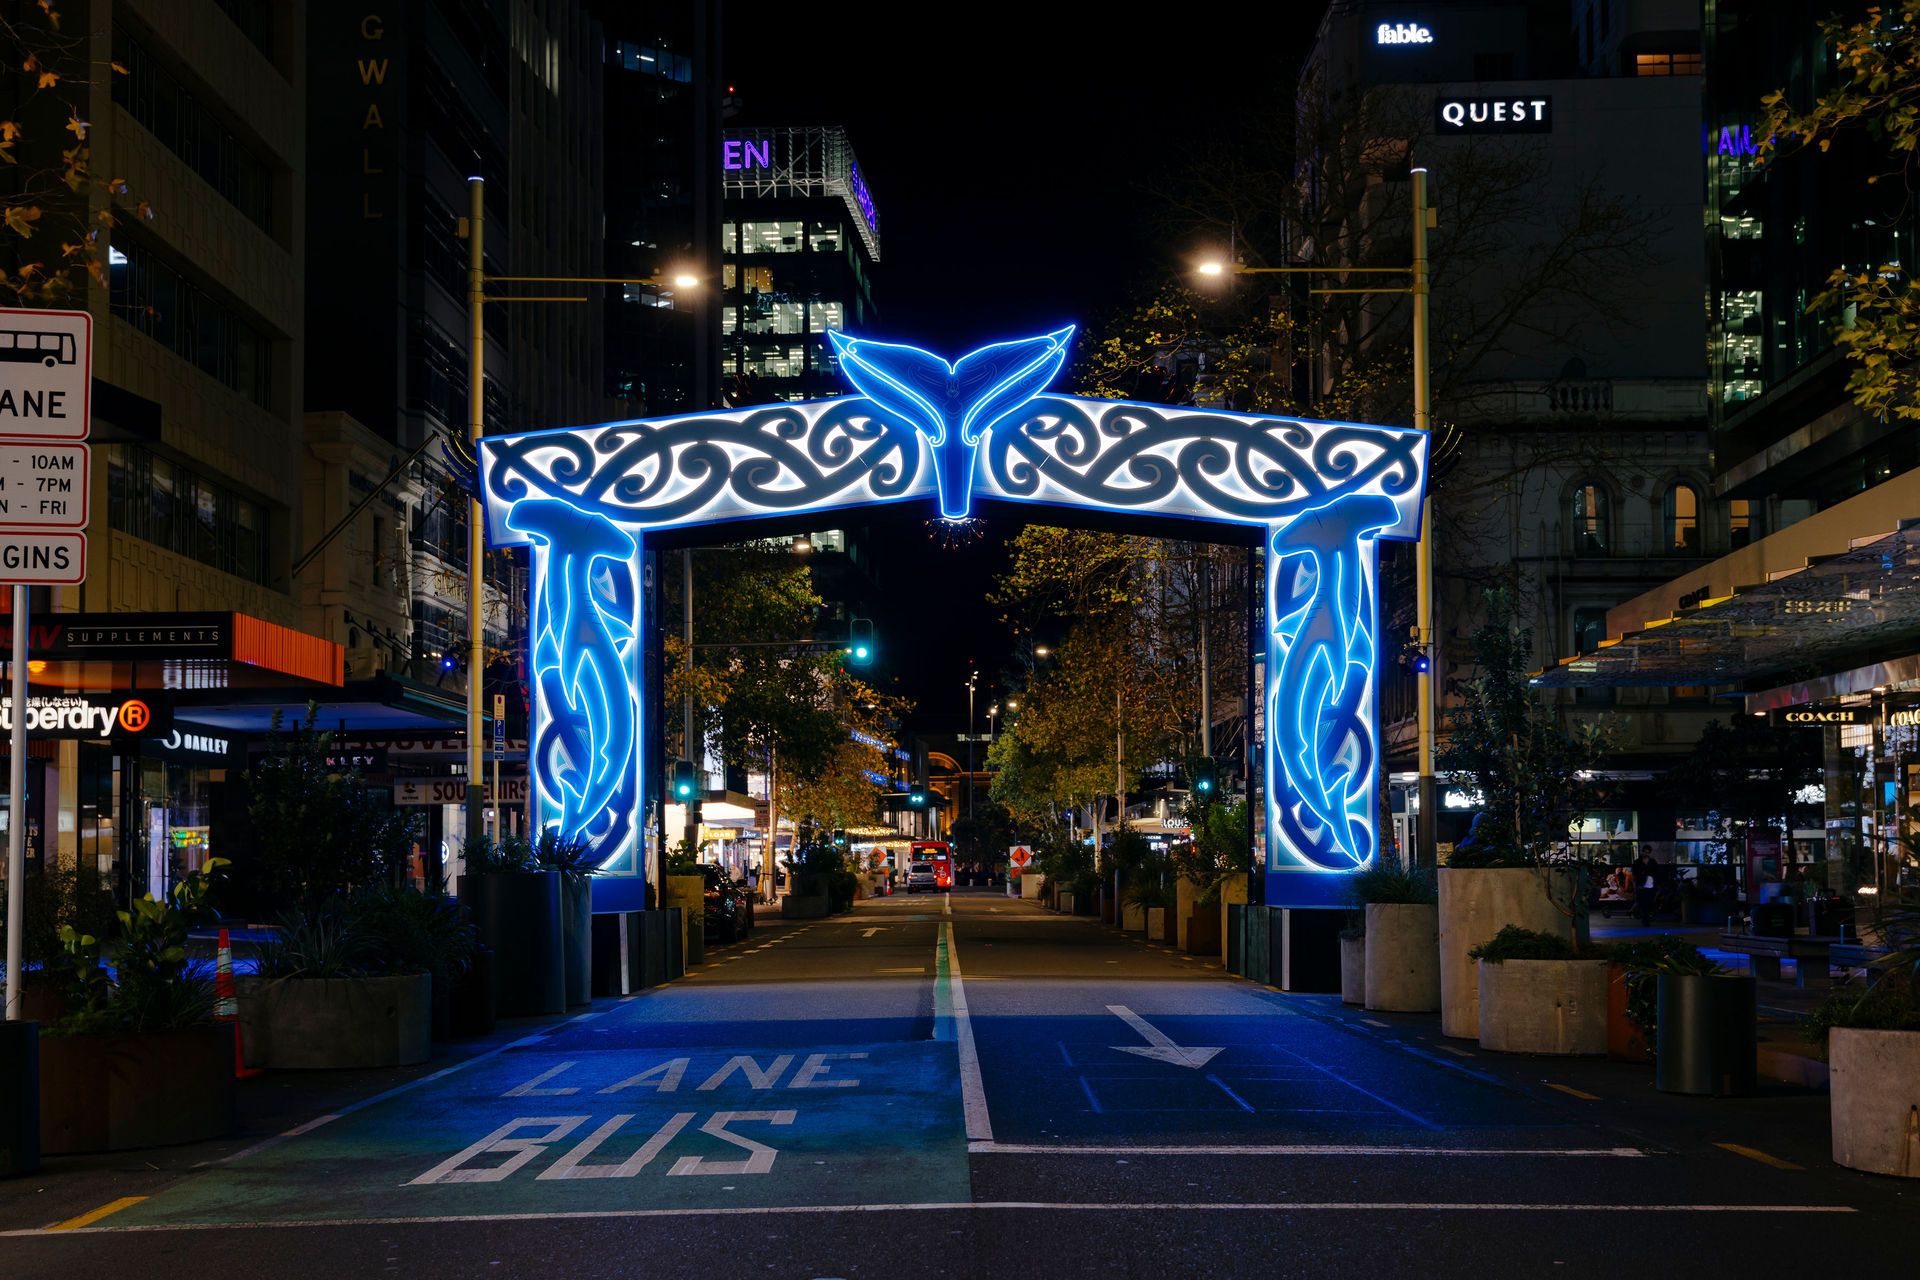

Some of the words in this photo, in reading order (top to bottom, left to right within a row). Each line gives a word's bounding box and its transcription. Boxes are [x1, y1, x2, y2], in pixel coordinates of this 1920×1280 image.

[1377, 23, 1434, 44] fable.
[1442, 100, 1546, 127] QUEST
[723, 140, 769, 170] EN
[31, 455, 74, 470] 10AM
[36, 477, 71, 492] 7PM
[40, 500, 66, 515] FRI
[3, 545, 70, 570] GINS
[67, 631, 220, 643] SUPPLEMENTS
[0, 700, 119, 736] uperdry
[1785, 712, 1855, 723] COACH
[184, 733, 229, 755] OAKLEY
[433, 780, 526, 801] SOUENIRS
[742, 829, 757, 839] Dior
[501, 1052, 869, 1097] LANE
[400, 1109, 798, 1187] BUS
